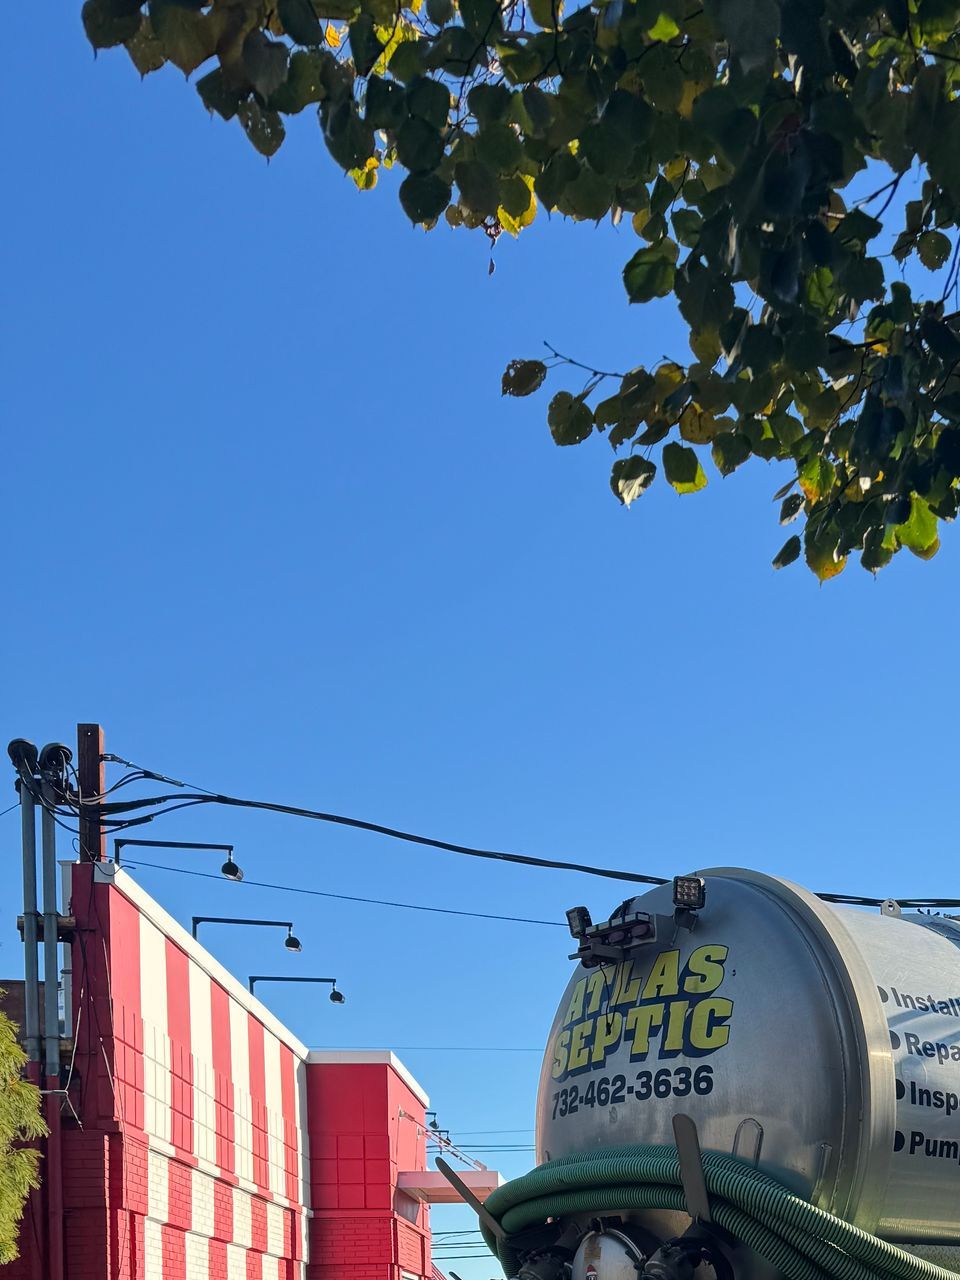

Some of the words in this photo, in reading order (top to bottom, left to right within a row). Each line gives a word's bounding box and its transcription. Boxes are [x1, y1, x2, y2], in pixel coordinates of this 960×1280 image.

[562, 944, 729, 1029] ATLAS
[551, 996, 734, 1081] SEPTIC
[552, 1065, 714, 1120] 732-462-3636
